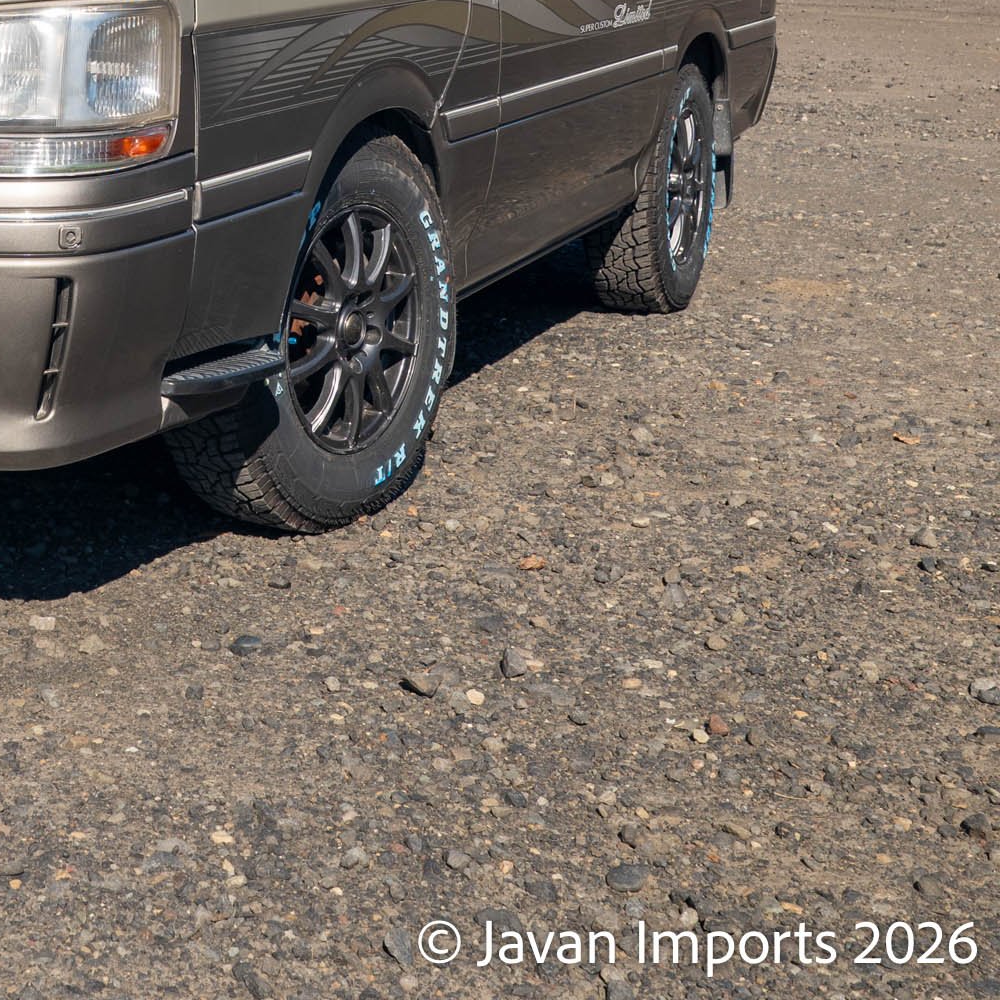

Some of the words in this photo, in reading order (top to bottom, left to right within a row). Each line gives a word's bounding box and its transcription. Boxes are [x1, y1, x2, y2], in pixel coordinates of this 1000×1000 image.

[580, 23, 595, 34] SUPER
[594, 19, 613, 31] CUSTOM
[612, 0, 653, 28] Limited
[413, 209, 450, 440] GRANDTREK
[374, 442, 407, 487] R/T
